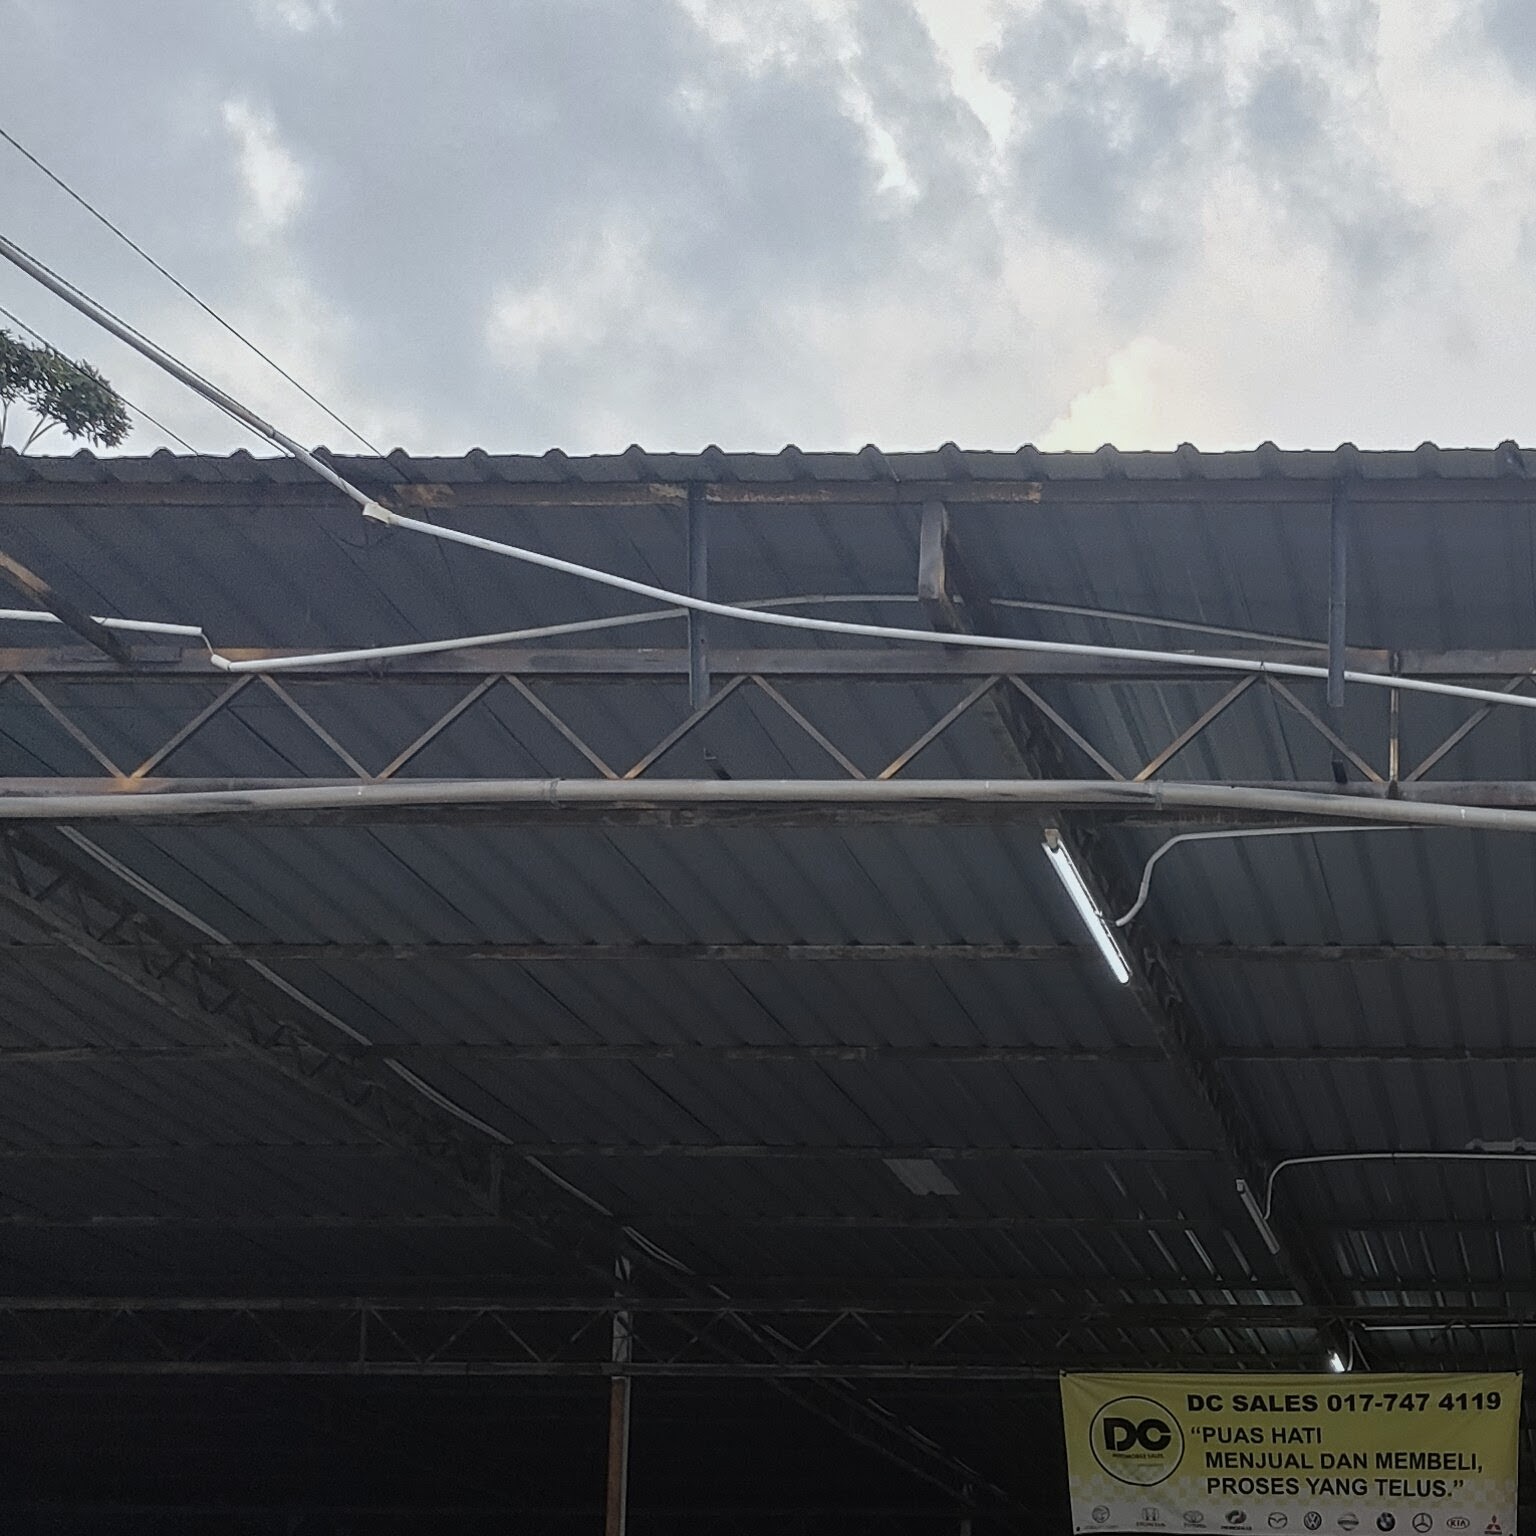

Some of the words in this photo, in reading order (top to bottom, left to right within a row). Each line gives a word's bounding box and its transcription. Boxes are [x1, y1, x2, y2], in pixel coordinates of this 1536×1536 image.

[1187, 1394, 1224, 1412] DC
[1232, 1394, 1319, 1412] SALES
[1327, 1393, 1430, 1412] 017-747
[1438, 1391, 1502, 1411] 4119
[1103, 1417, 1172, 1451] DC
[1272, 1427, 1322, 1444] HATI
[1206, 1452, 1314, 1469] MENJUAL
[1320, 1452, 1368, 1470] DAN
[1375, 1452, 1483, 1473] MEMBELI,
[1207, 1477, 1300, 1495] PROSES
[1306, 1477, 1368, 1496] YANG
